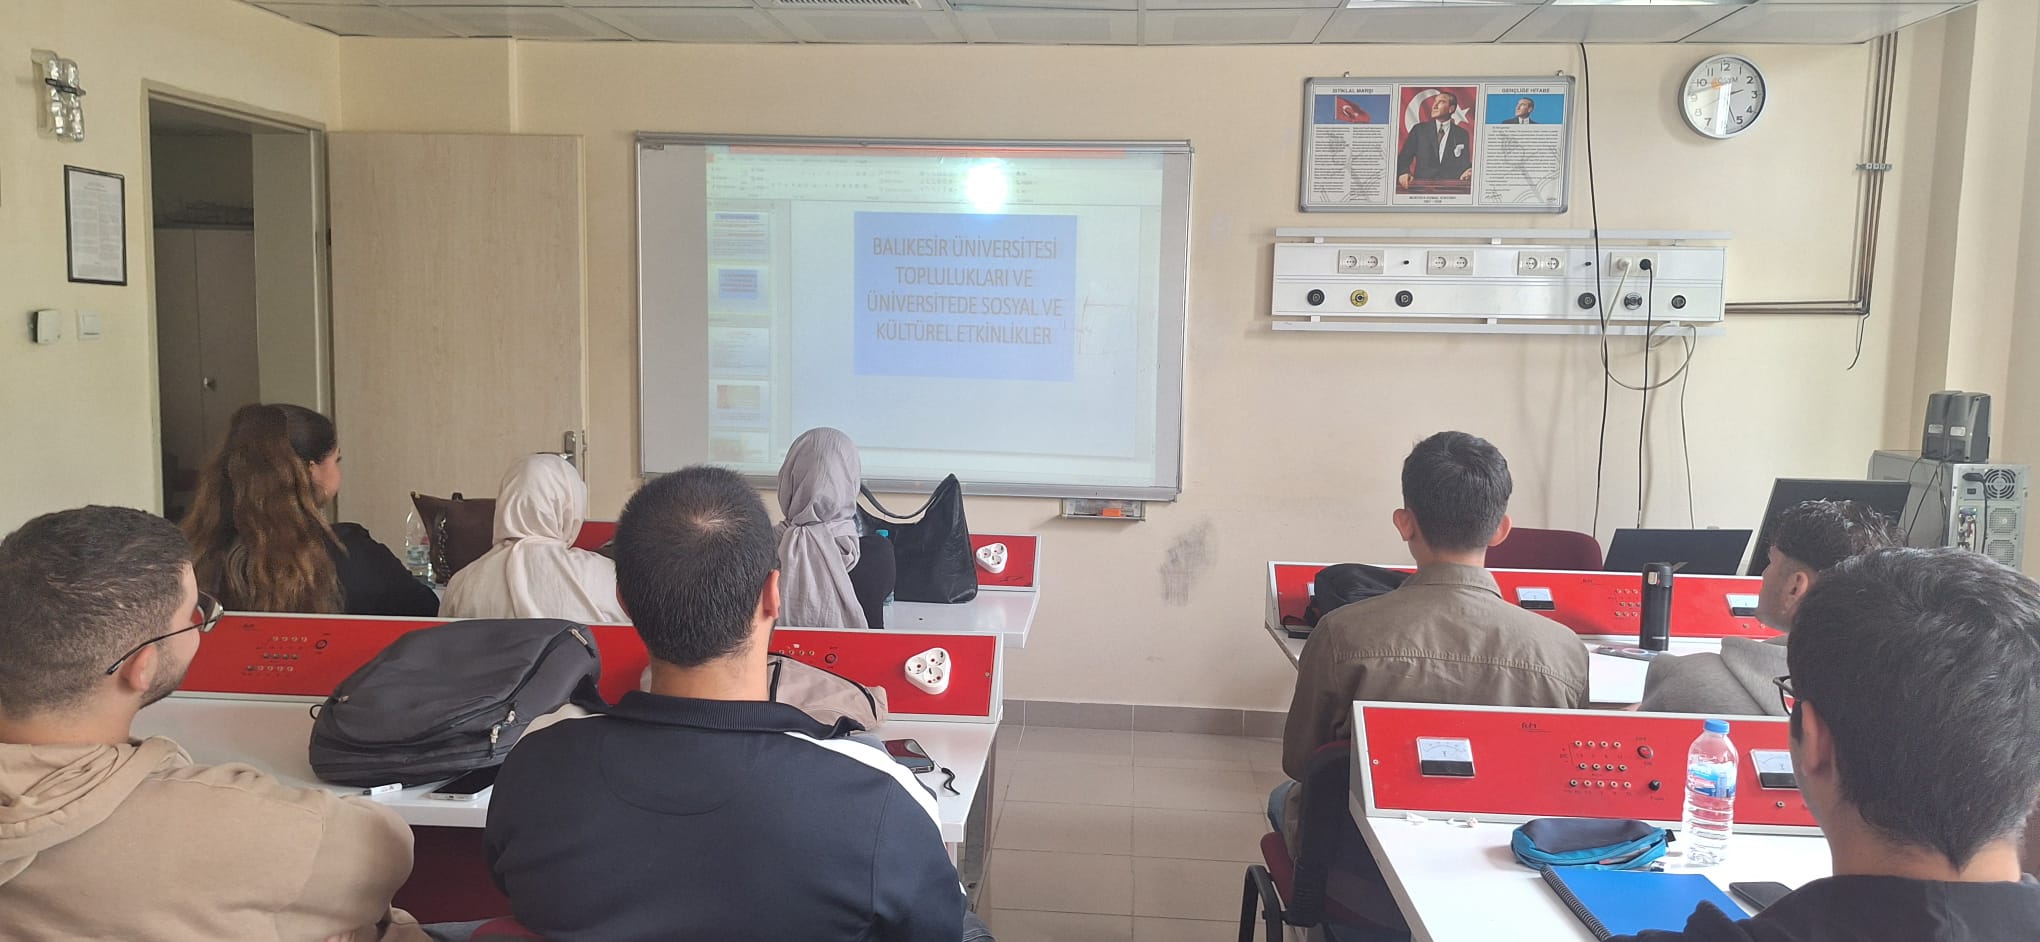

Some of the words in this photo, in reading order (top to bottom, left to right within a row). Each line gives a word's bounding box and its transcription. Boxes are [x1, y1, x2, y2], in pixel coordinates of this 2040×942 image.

[1720, 62, 1731, 71] 12
[1707, 67, 1714, 76] 11
[1696, 78, 1708, 87] 10
[1746, 76, 1754, 84] 2
[1751, 90, 1758, 99] 3
[1746, 105, 1754, 113] 4
[1704, 117, 1712, 126] 7
[1736, 115, 1743, 125] 5
[873, 235, 948, 256] BALIKESİR
[952, 235, 1057, 259] ÜNİVERSİTESİ
[895, 266, 1008, 287] TOPLULUKLARI
[1013, 269, 1033, 287] VE
[867, 290, 977, 314] ÜNİVERSİTEDE
[982, 296, 1039, 316] SOSYAL
[1042, 298, 1064, 317] VE
[876, 319, 952, 342] KÜLTÜREL
[957, 321, 1052, 344] ETKİNLİKLER
